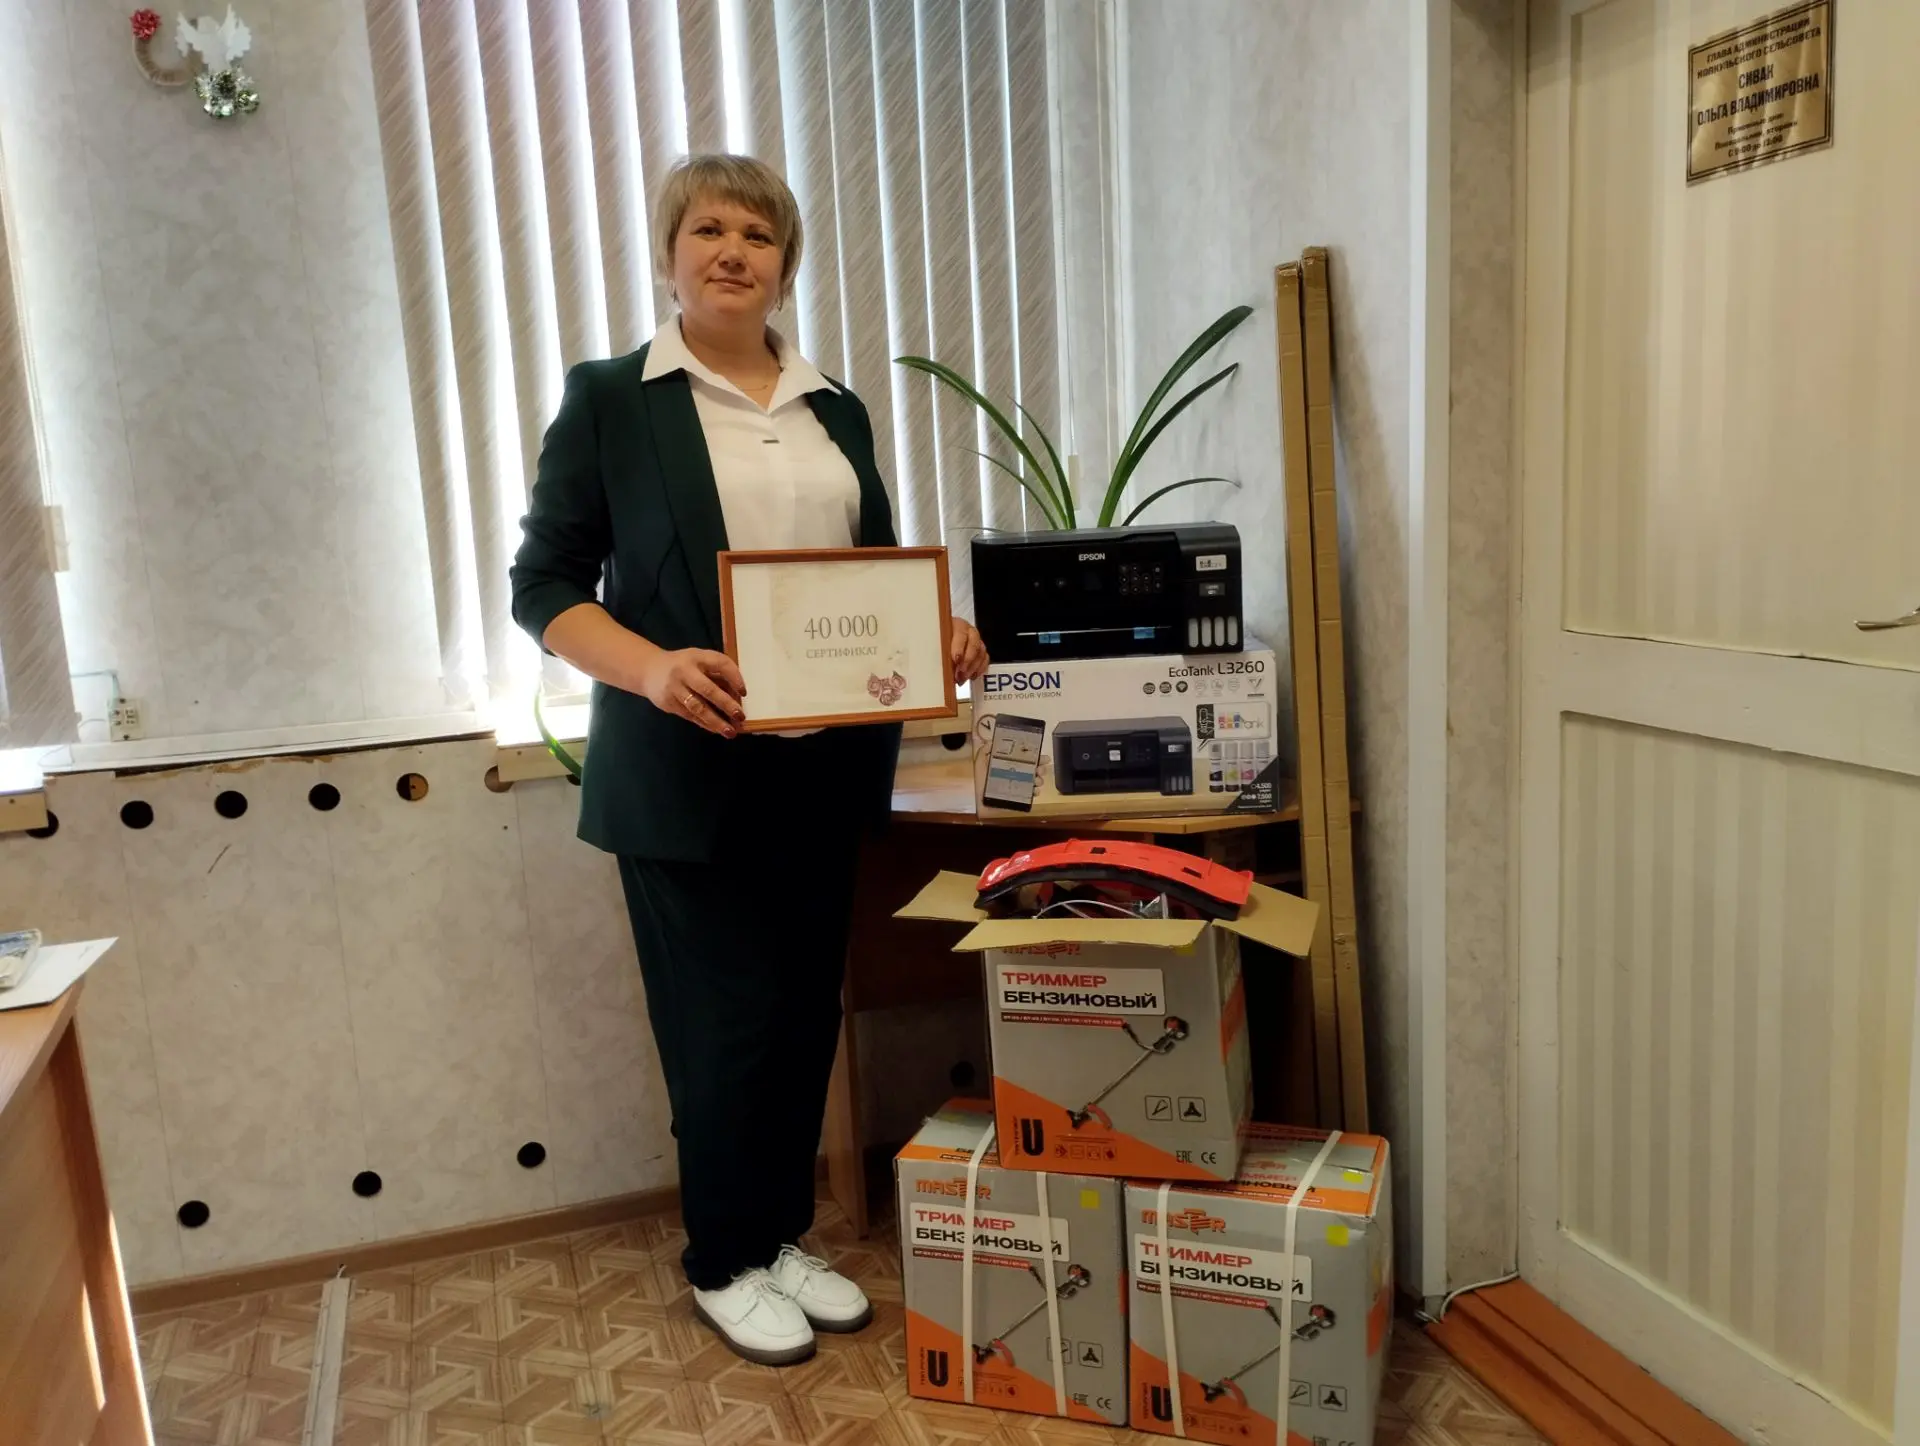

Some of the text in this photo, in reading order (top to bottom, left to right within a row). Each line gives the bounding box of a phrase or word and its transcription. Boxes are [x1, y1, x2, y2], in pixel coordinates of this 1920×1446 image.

[1763, 27, 1821, 56] СЕЛЬСОВЕТА
[1707, 46, 1736, 63] ГЛАВА
[1738, 63, 1774, 89] СИВАК
[1697, 102, 1728, 126] ОЛЬГА
[1730, 73, 1819, 115] ВЛАДИМИРОВНА
[1078, 553, 1106, 561] EPSON
[804, 614, 879, 640] 40 000
[805, 646, 878, 659] СЕРТИФИКАТ
[1168, 660, 1265, 678] EcoTank L3260
[983, 671, 1061, 692] EPSON
[984, 691, 1062, 701] EXCEED YOUR VISION
[1002, 971, 1107, 988] ТРИММЕР
[1003, 991, 1157, 1009] БЕНЗИНОВЫЙ
